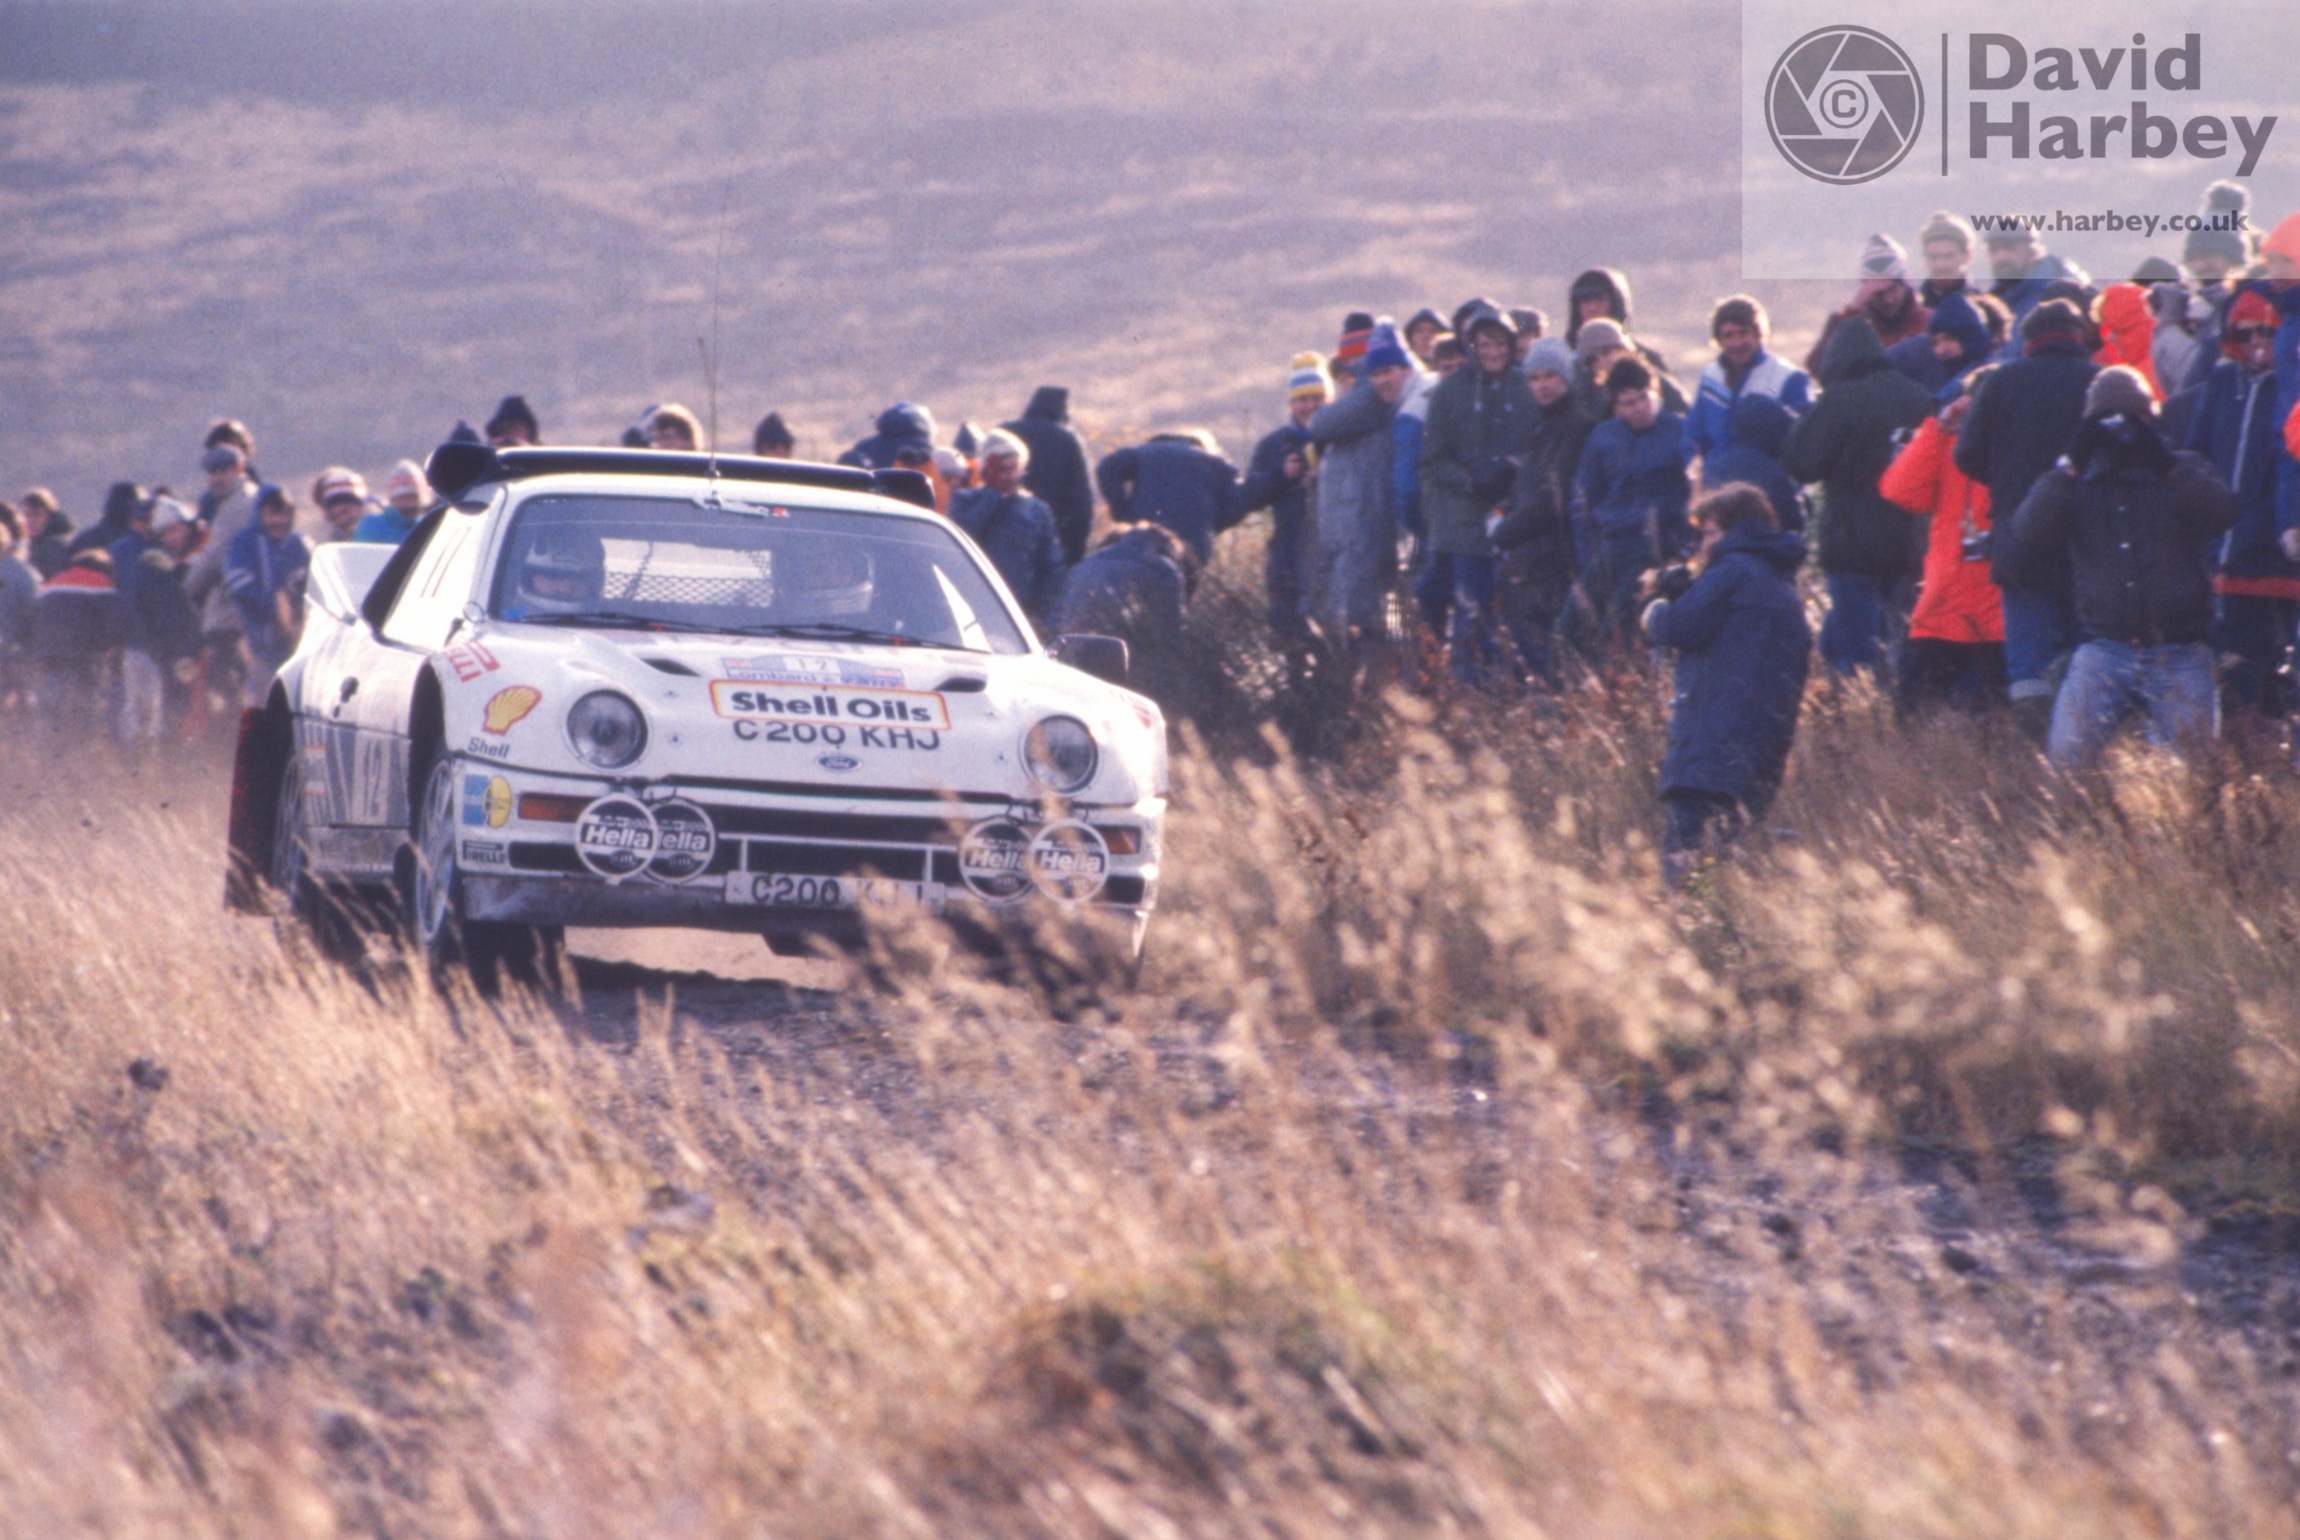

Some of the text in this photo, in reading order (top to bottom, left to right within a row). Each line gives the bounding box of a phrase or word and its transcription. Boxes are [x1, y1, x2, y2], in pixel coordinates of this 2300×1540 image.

[725, 669, 817, 682] Lombard
[731, 692, 932, 722] Shell Oils
[468, 736, 510, 759] Shell
[859, 727, 940, 750] KHJ
[585, 824, 650, 849] Hella
[659, 830, 707, 852] ella
[1041, 850, 1101, 873] Hella
[751, 874, 841, 906] C200
